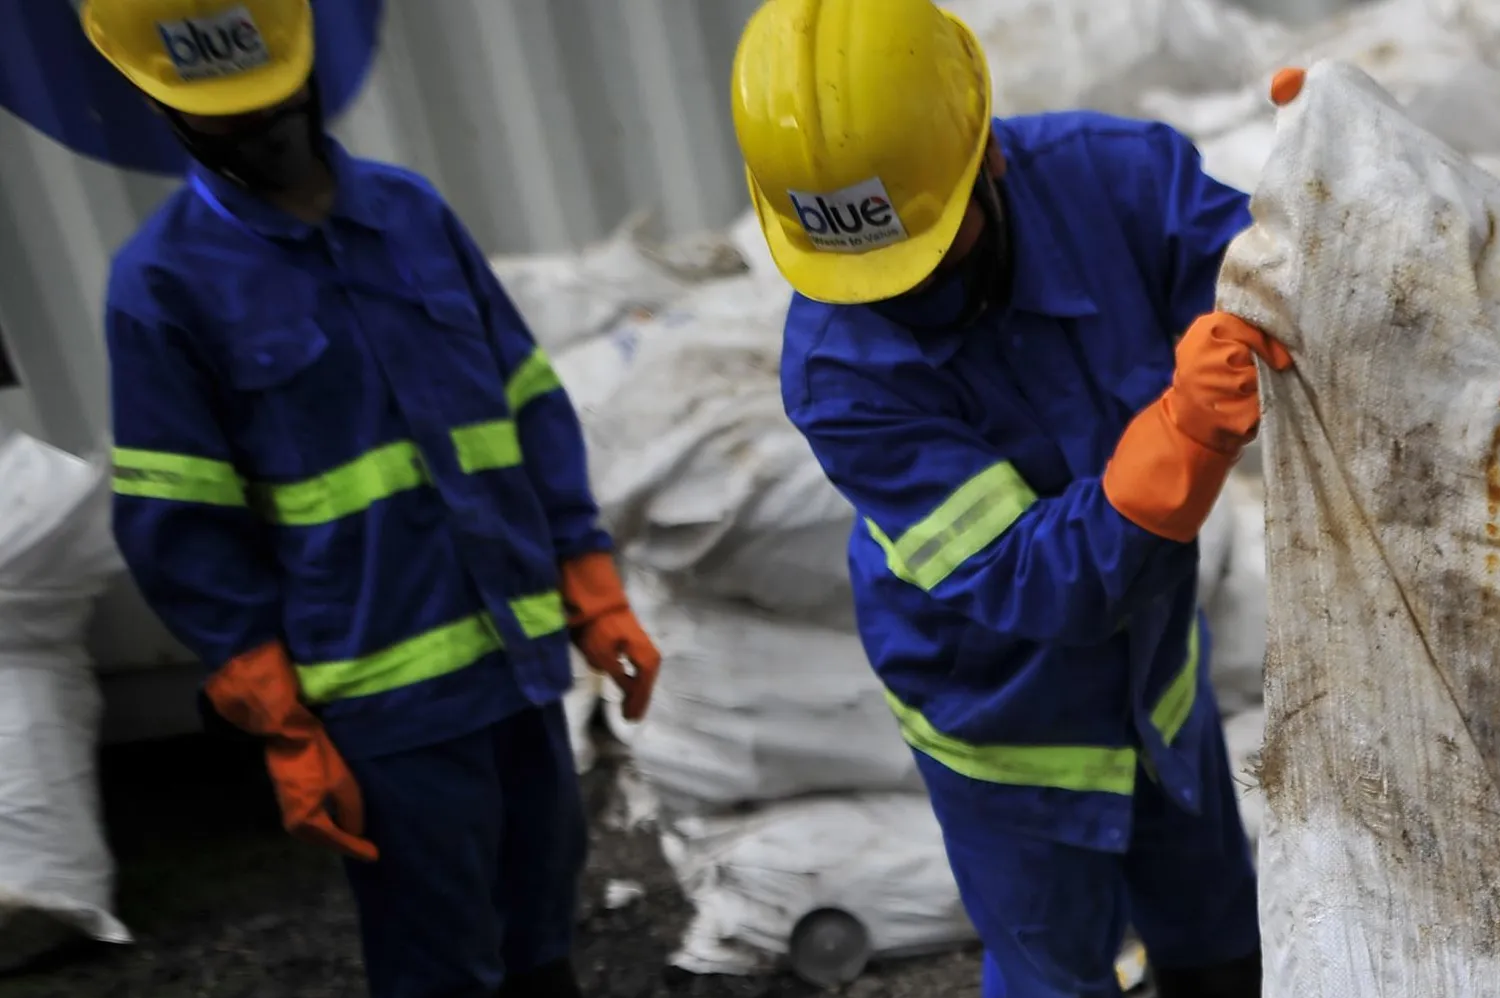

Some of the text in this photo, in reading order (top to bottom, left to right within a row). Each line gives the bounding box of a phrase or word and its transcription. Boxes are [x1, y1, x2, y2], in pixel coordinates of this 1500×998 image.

[159, 17, 261, 67] blue
[789, 194, 892, 234] blue
[812, 228, 900, 247] Waste to Value
